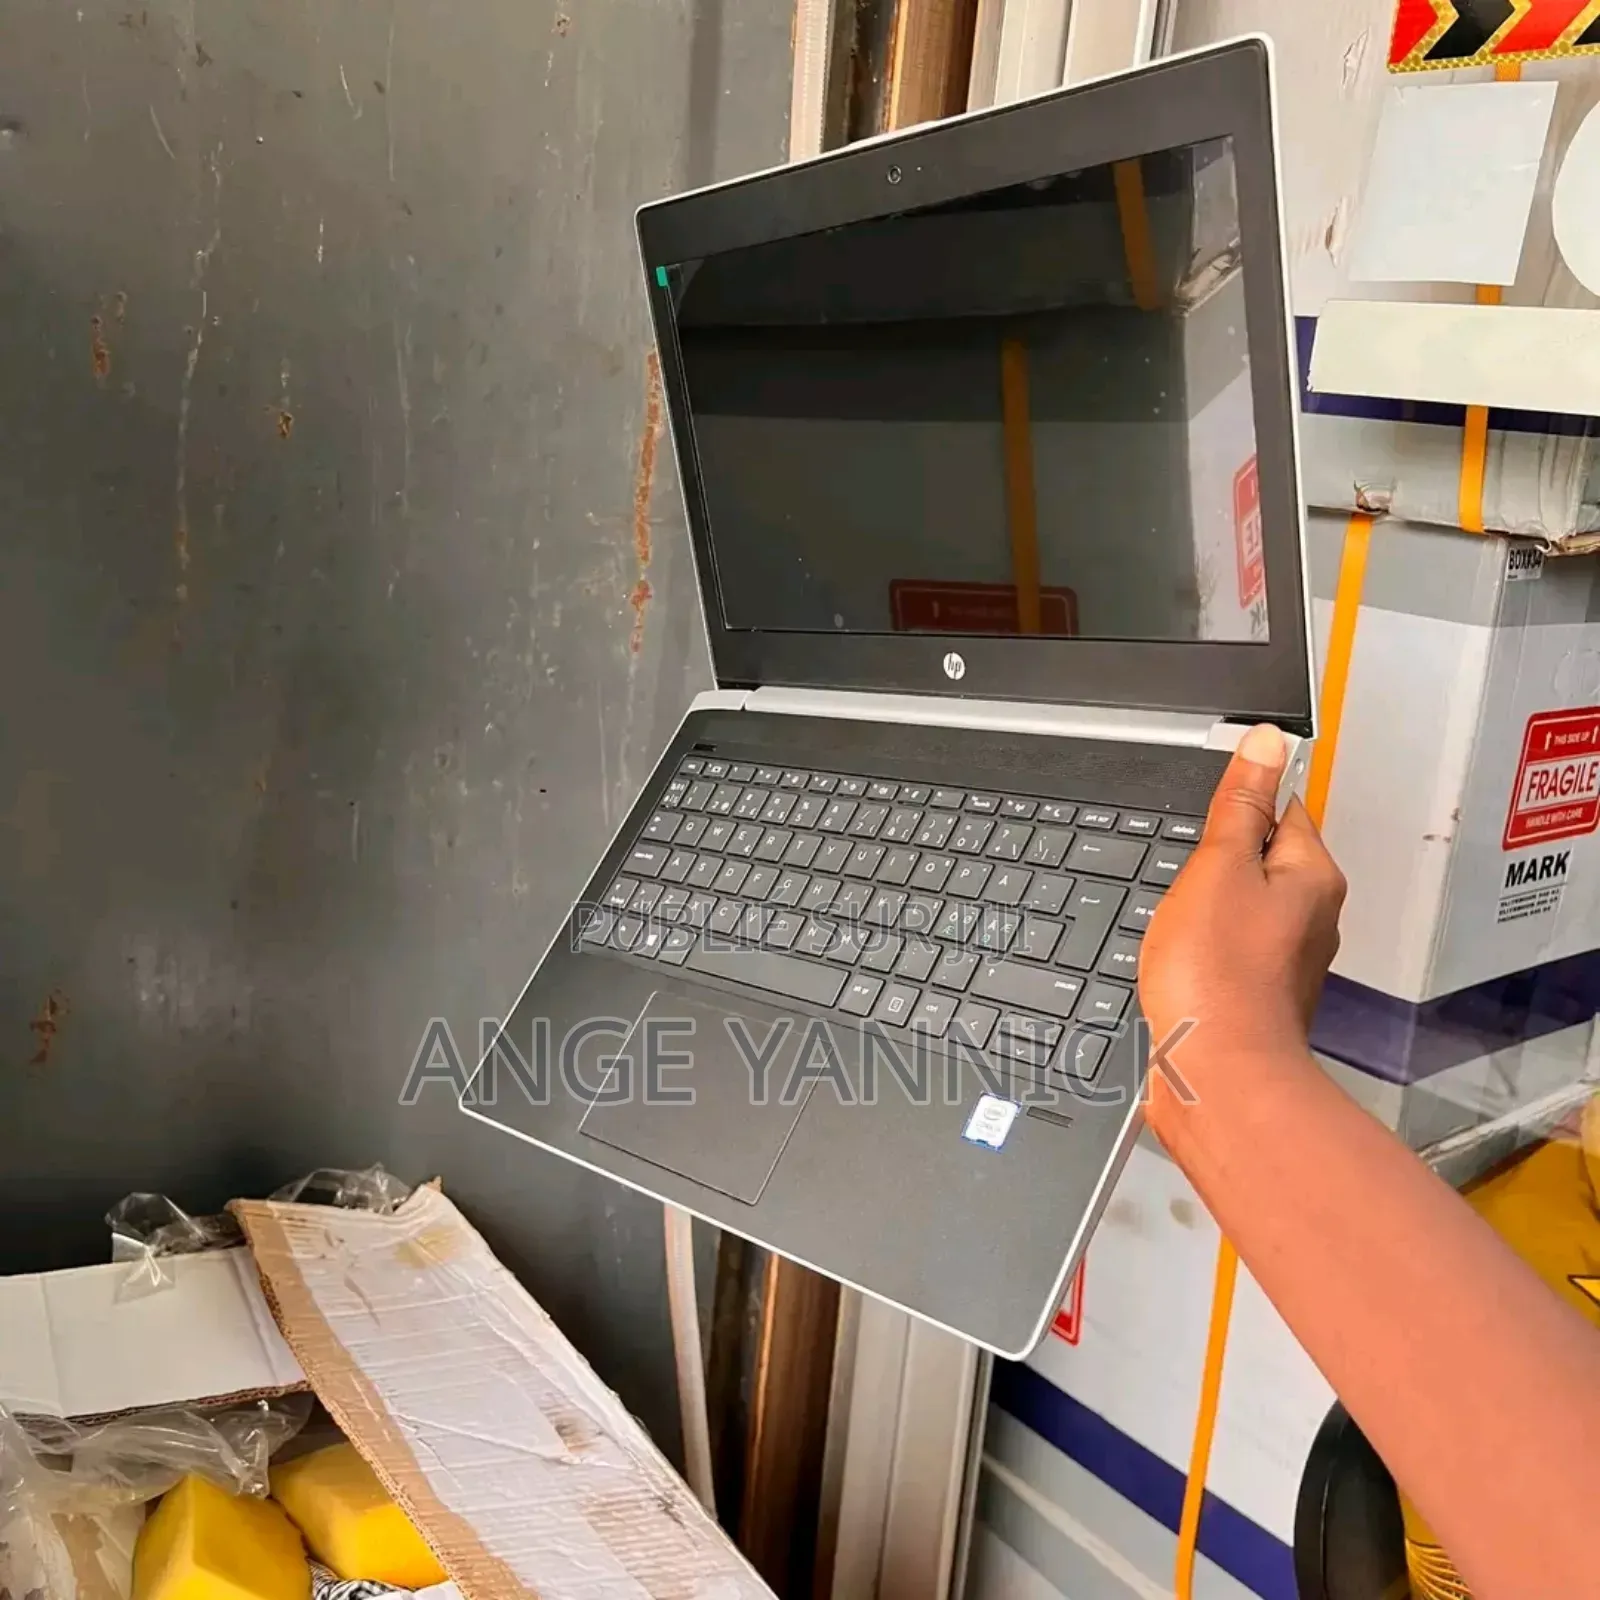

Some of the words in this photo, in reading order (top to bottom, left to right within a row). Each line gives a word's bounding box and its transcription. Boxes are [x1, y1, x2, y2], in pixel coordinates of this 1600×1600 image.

[944, 652, 965, 680] hp
[1525, 761, 1599, 803] FRAGILE
[712, 826, 724, 836] W
[738, 830, 748, 840] E
[765, 836, 776, 845] R
[796, 840, 805, 849] T
[827, 846, 836, 855] Y
[857, 850, 868, 860] U
[1156, 860, 1179, 870] home
[1504, 849, 1571, 888] MARK
[960, 868, 970, 878] P
[664, 894, 674, 904] Z
[719, 906, 729, 916] C
[749, 913, 759, 922] V
[807, 927, 818, 937] N
